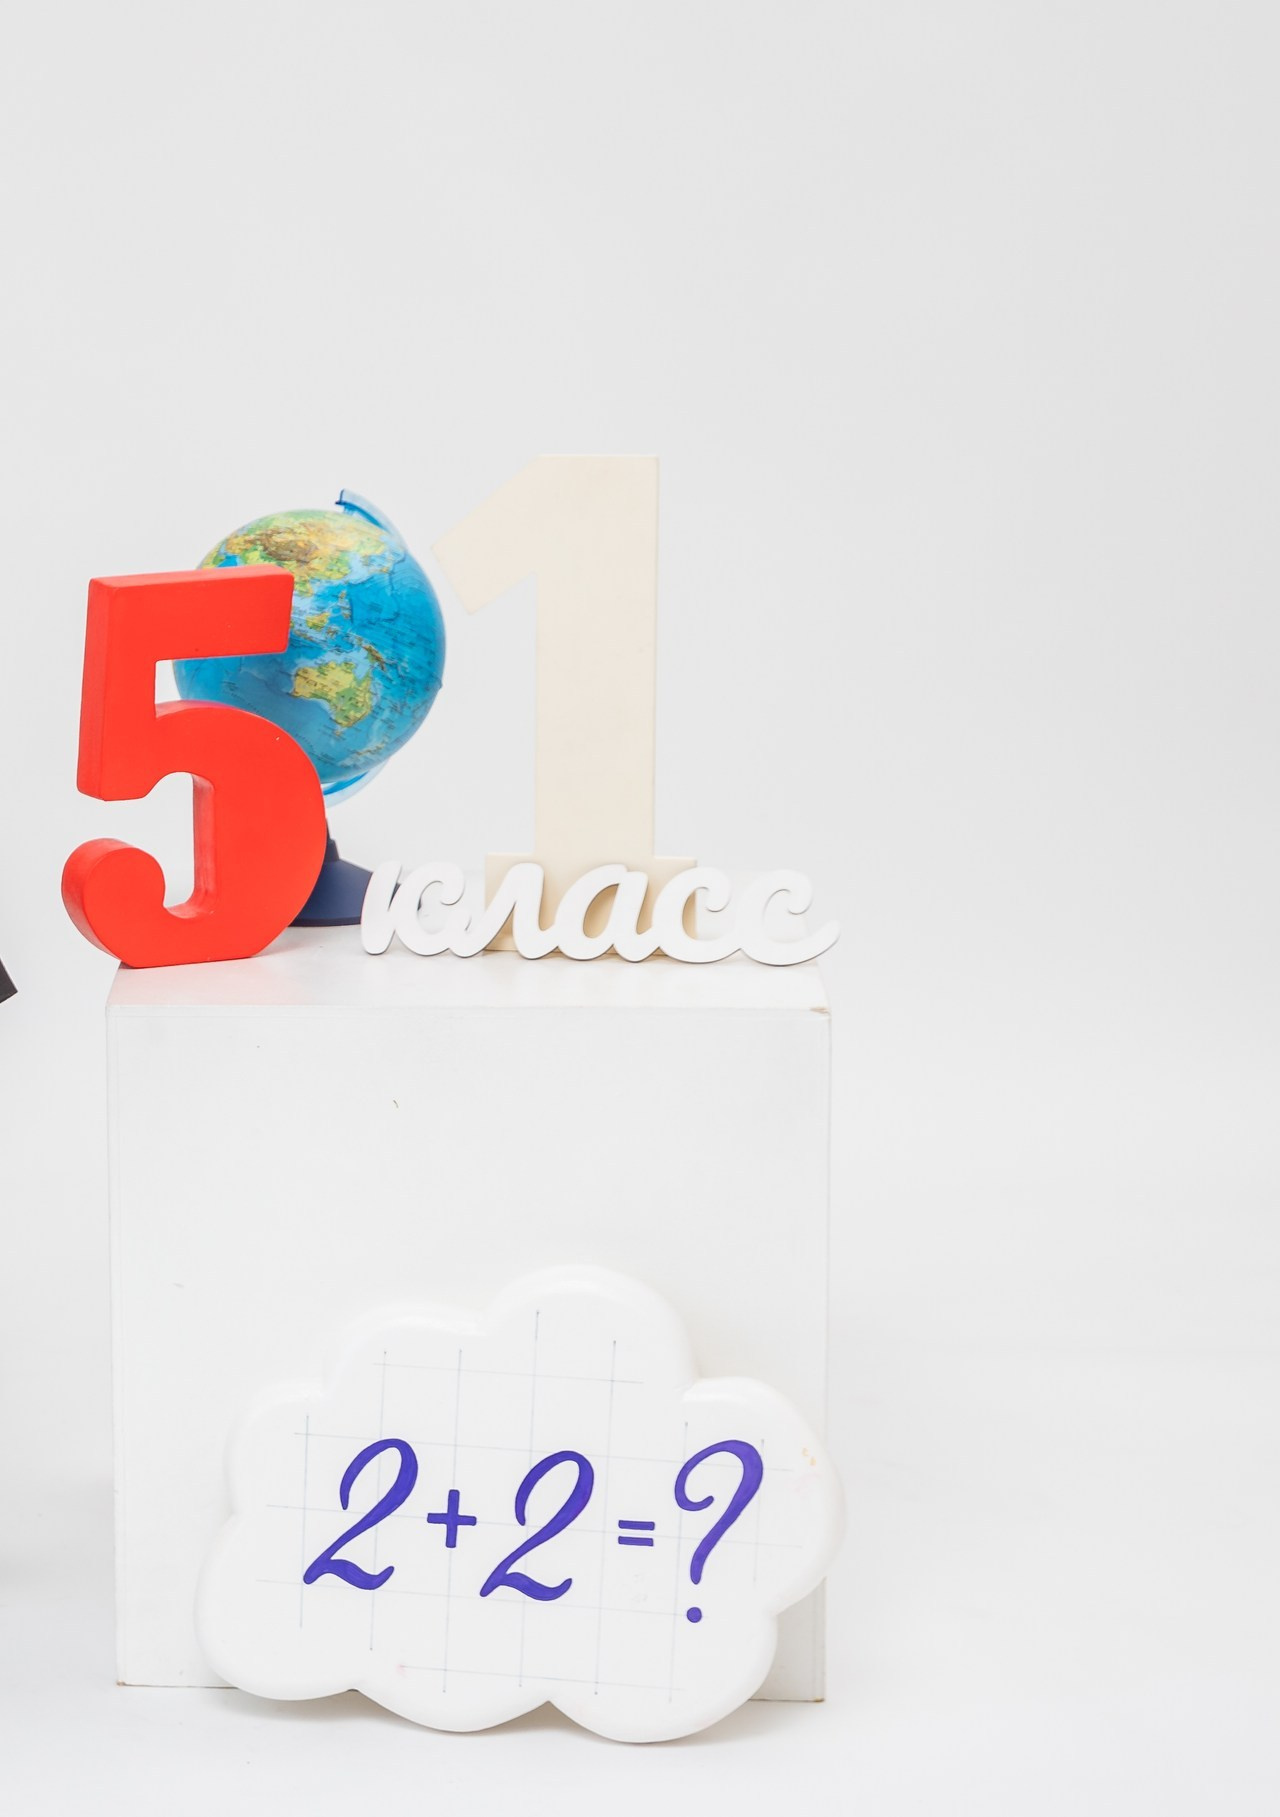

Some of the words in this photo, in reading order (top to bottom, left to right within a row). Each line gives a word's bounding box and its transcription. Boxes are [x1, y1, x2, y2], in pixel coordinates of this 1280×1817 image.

[61, 564, 327, 969] 5
[433, 453, 697, 957] 1
[360, 860, 840, 967] класс
